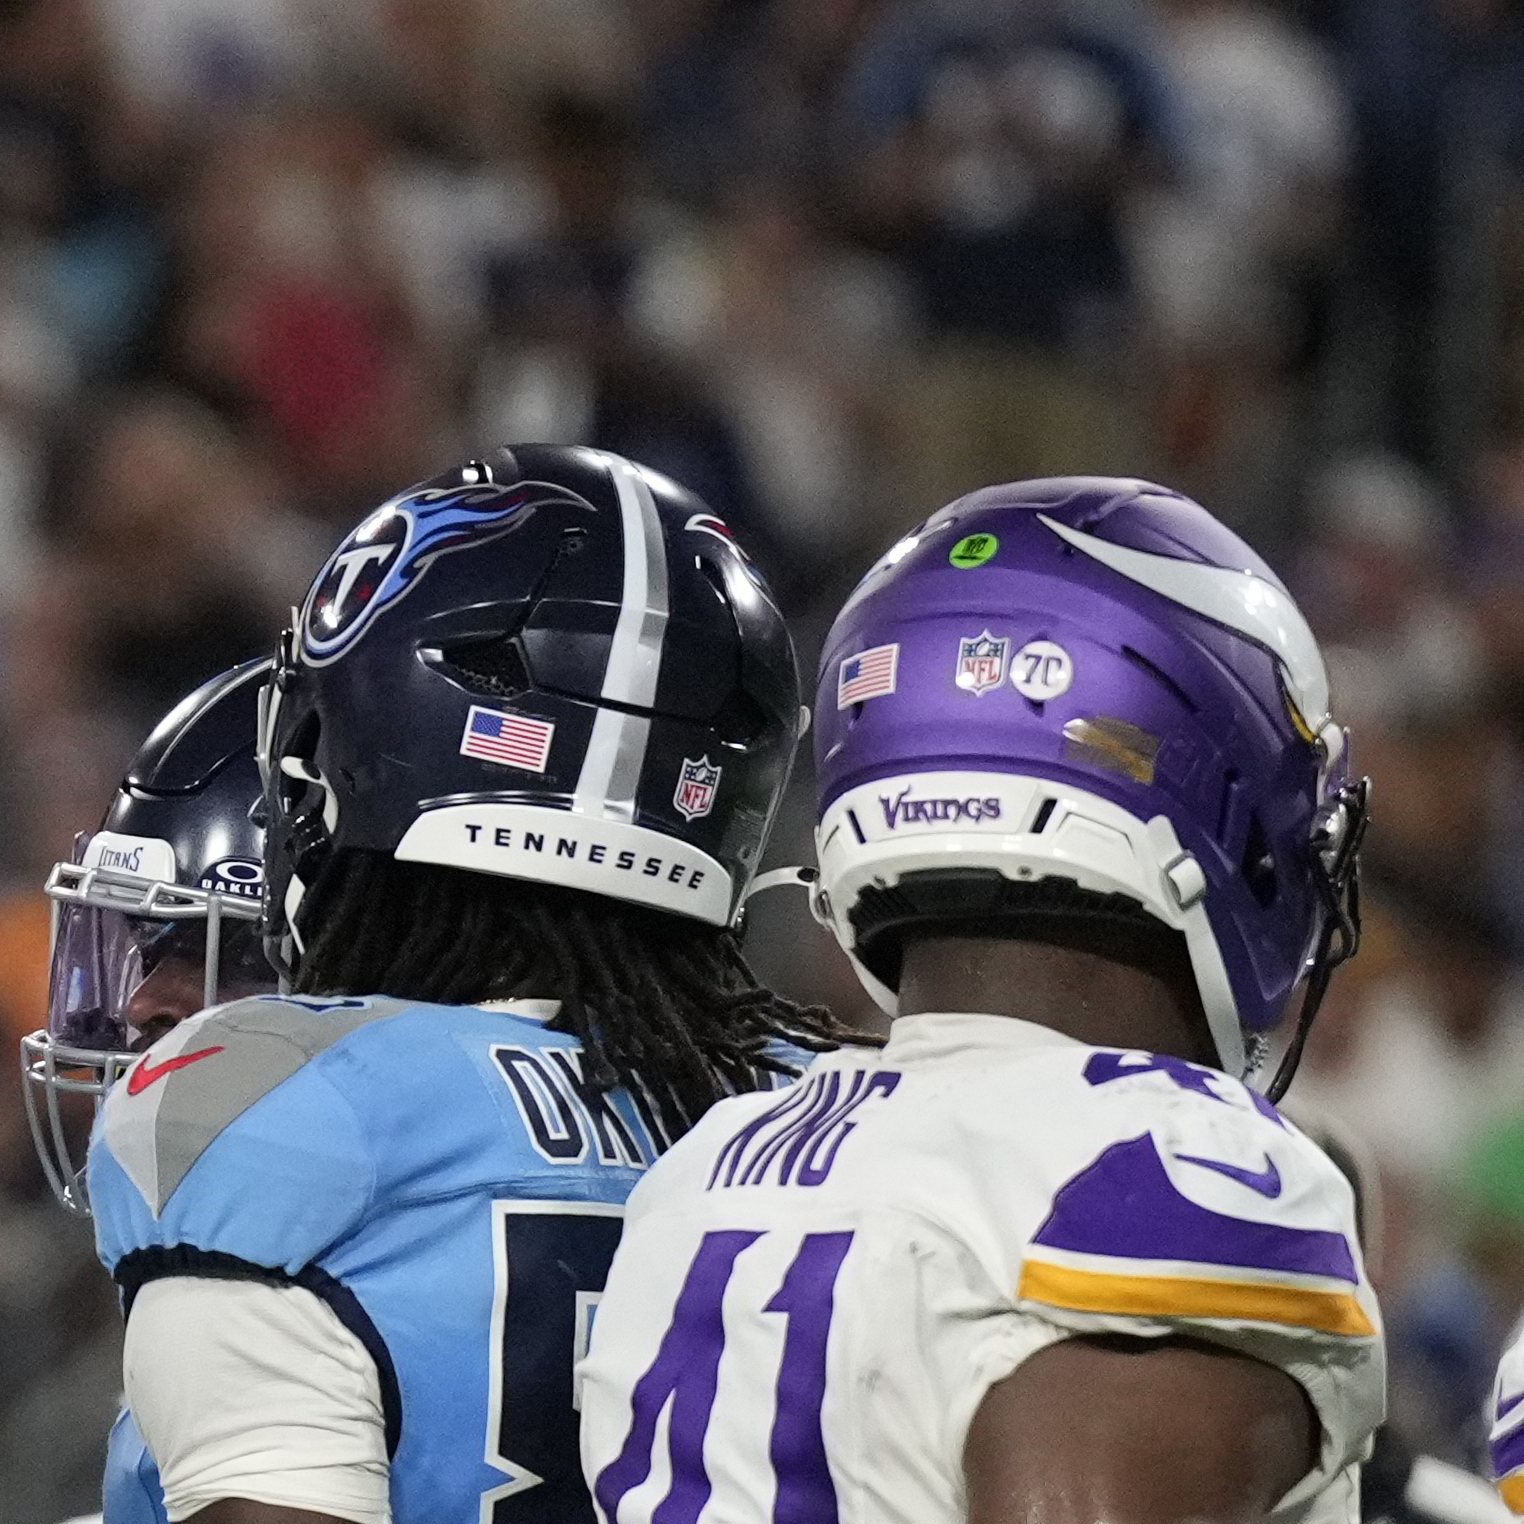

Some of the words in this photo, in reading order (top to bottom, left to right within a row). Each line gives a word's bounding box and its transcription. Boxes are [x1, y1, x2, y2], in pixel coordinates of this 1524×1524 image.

[964, 658, 998, 684] NFL
[679, 781, 709, 812] NFL
[465, 824, 705, 890] TENNESSEE
[706, 1069, 902, 1191] KING
